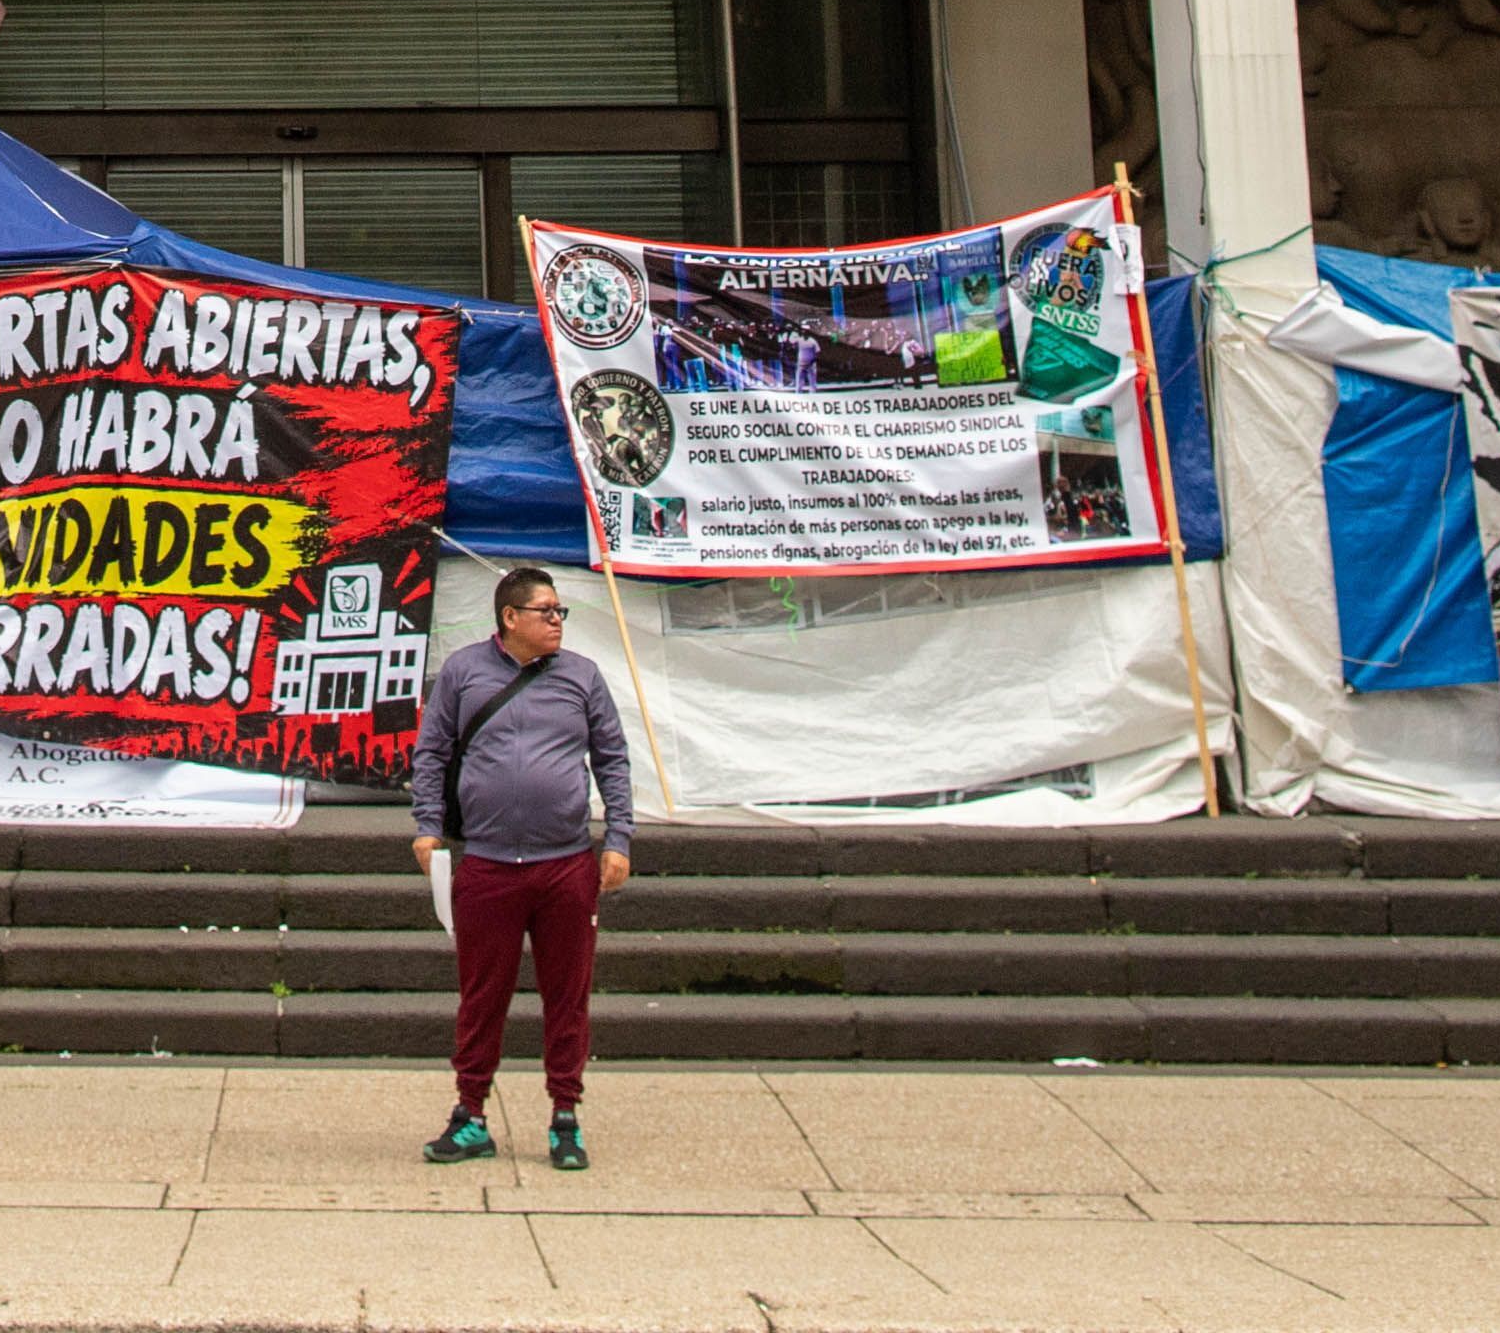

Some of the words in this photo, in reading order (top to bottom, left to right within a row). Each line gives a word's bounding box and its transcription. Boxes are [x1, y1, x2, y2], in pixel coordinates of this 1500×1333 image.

[1031, 247, 1097, 275] FUERA
[718, 262, 929, 291] ALTERNATIVA..
[1040, 305, 1099, 334] SNTSS
[144, 288, 432, 407] ABIERTAS,
[710, 400, 738, 416] UNE
[776, 399, 820, 415] LUCHA
[846, 399, 872, 415] LOS
[875, 393, 985, 415] TRABAJADORES
[989, 391, 1015, 407] DEL
[57, 383, 259, 482] HABRÁ
[687, 424, 740, 440] SEGURO
[744, 421, 793, 438] SOCIAL
[796, 421, 851, 437] CONTRA
[875, 419, 957, 438] CHARRISMO
[960, 414, 1024, 432] SINDICAL
[688, 449, 717, 465] POR
[739, 445, 842, 463] CUMPLIMIENTO
[896, 441, 975, 461] DEMANDAS
[1001, 437, 1027, 453] LOS
[801, 469, 916, 486] TRABAJADORES:
[701, 496, 746, 513] salario
[748, 496, 785, 515] justo,
[789, 493, 844, 511] insumos
[863, 492, 897, 508] 100%
[919, 489, 958, 507] todas
[984, 486, 1024, 505] áreas,
[701, 516, 786, 537] contratación
[841, 517, 901, 539] personas
[933, 515, 975, 536] apego
[700, 545, 768, 563] pensiones
[772, 542, 821, 563] dignas,
[823, 539, 900, 560] abrogación
[332, 615, 367, 629] IMSS
